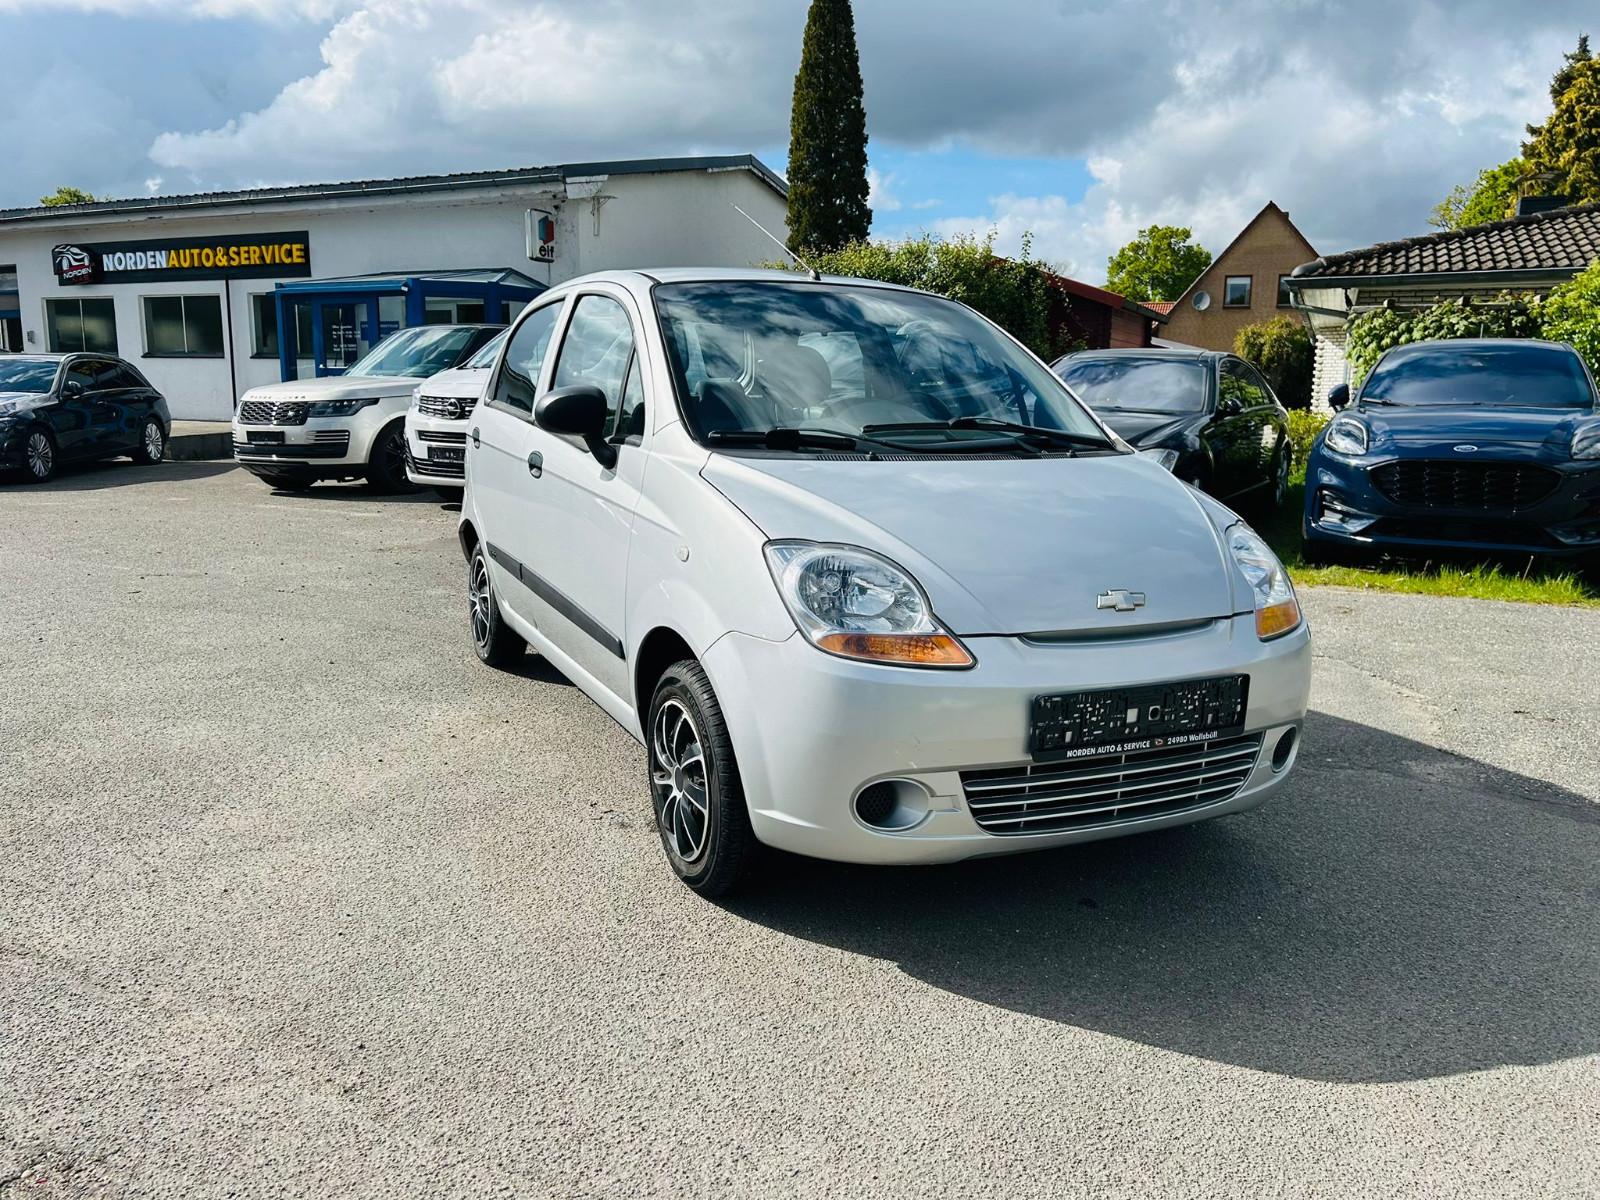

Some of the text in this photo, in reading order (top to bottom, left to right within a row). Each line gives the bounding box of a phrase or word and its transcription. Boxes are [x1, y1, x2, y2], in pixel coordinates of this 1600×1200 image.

[539, 245, 554, 258] elf
[63, 266, 92, 280] NORDEN
[1066, 747, 1096, 758] NORDEN
[1097, 745, 1116, 754] AUTO
[1116, 743, 1122, 752] &
[1123, 740, 1151, 751] SERVICE
[1167, 735, 1188, 745] 24980
